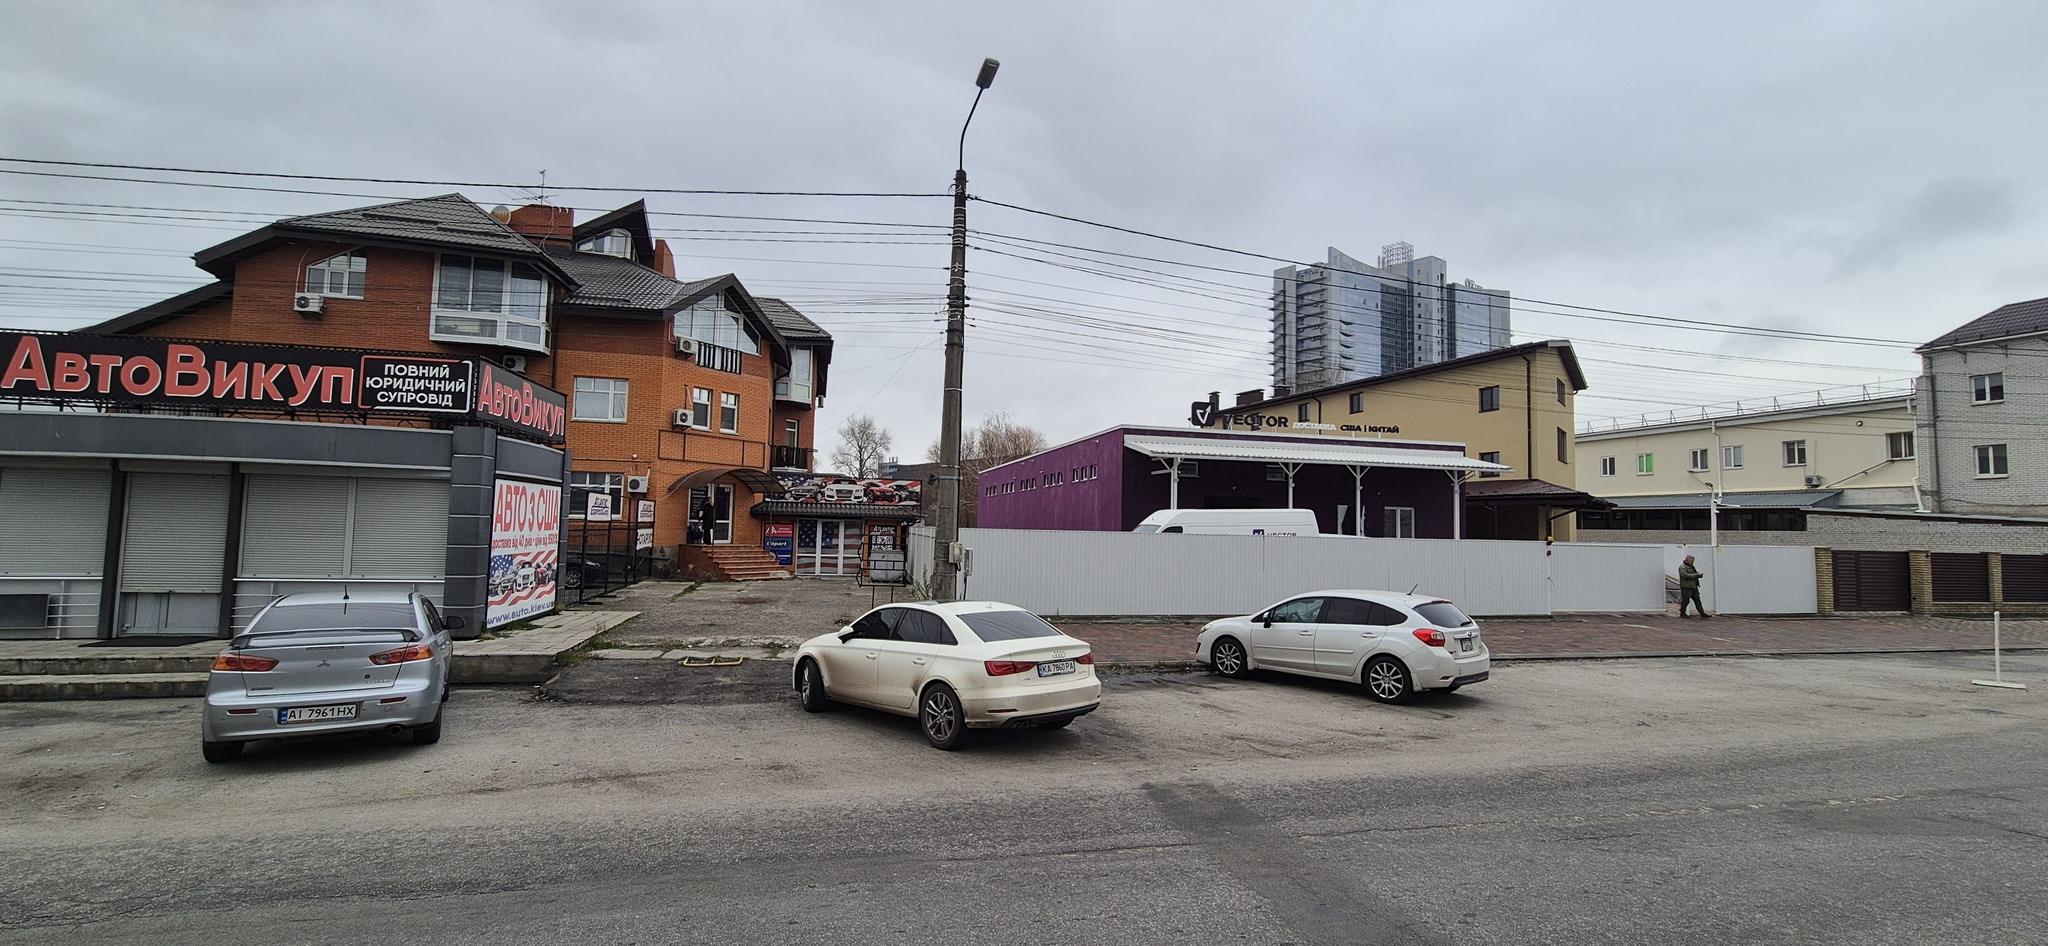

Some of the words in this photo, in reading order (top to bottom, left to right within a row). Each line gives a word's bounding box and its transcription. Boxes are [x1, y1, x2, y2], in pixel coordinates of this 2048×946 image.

[0, 336, 354, 406] АвтоВикуп
[384, 364, 450, 378] ПОВНИЙ
[365, 377, 466, 392] ЮРИДИЧНИЙ
[376, 391, 453, 407] СУПРОВІД
[478, 365, 565, 437] АвтоВикуп
[1223, 413, 1289, 428] VECTOR
[1340, 424, 1362, 432] США
[1368, 425, 1400, 434] КИТАЙ
[494, 484, 527, 533] АВТО
[536, 488, 559, 531] США
[492, 538, 511, 550] доставка
[288, 710, 302, 719] AI
[308, 707, 335, 718] 7961
[337, 706, 354, 716] HX
